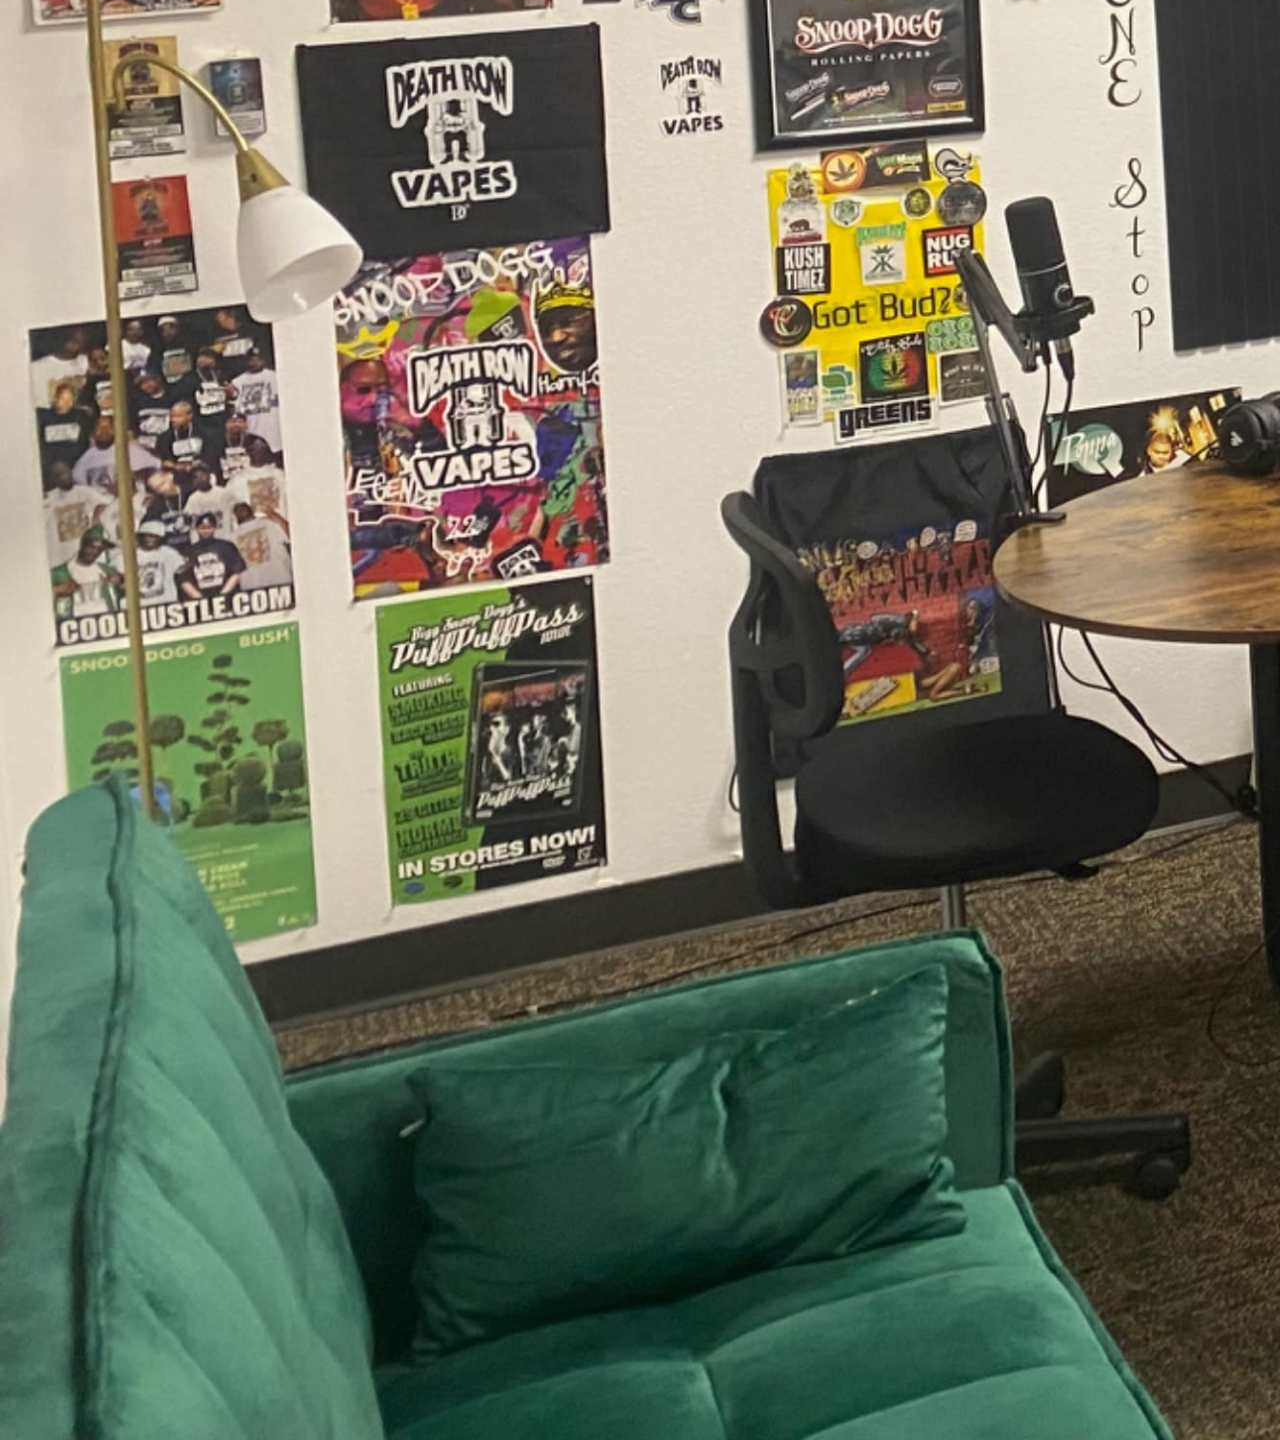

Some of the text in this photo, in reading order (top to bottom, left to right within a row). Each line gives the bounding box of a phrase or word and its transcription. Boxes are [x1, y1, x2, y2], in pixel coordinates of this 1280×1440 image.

[795, 8, 944, 49] SNOOP DOGG
[811, 55, 873, 66] ROLLING
[391, 60, 507, 119] DEATH ROW
[662, 115, 724, 136] VAPES
[397, 166, 512, 202] VAPES
[784, 246, 825, 271] KUSH
[926, 233, 971, 251] NUG
[445, 242, 554, 292] DOGG
[784, 268, 825, 291] TIMEZ
[813, 287, 952, 331] Got Bud?
[414, 344, 531, 413] DEATH ROW
[417, 449, 533, 489] VAPES
[69, 628, 291, 675] SNOO DOGG BUSH
[399, 825, 597, 879] IN STORES NOW!
